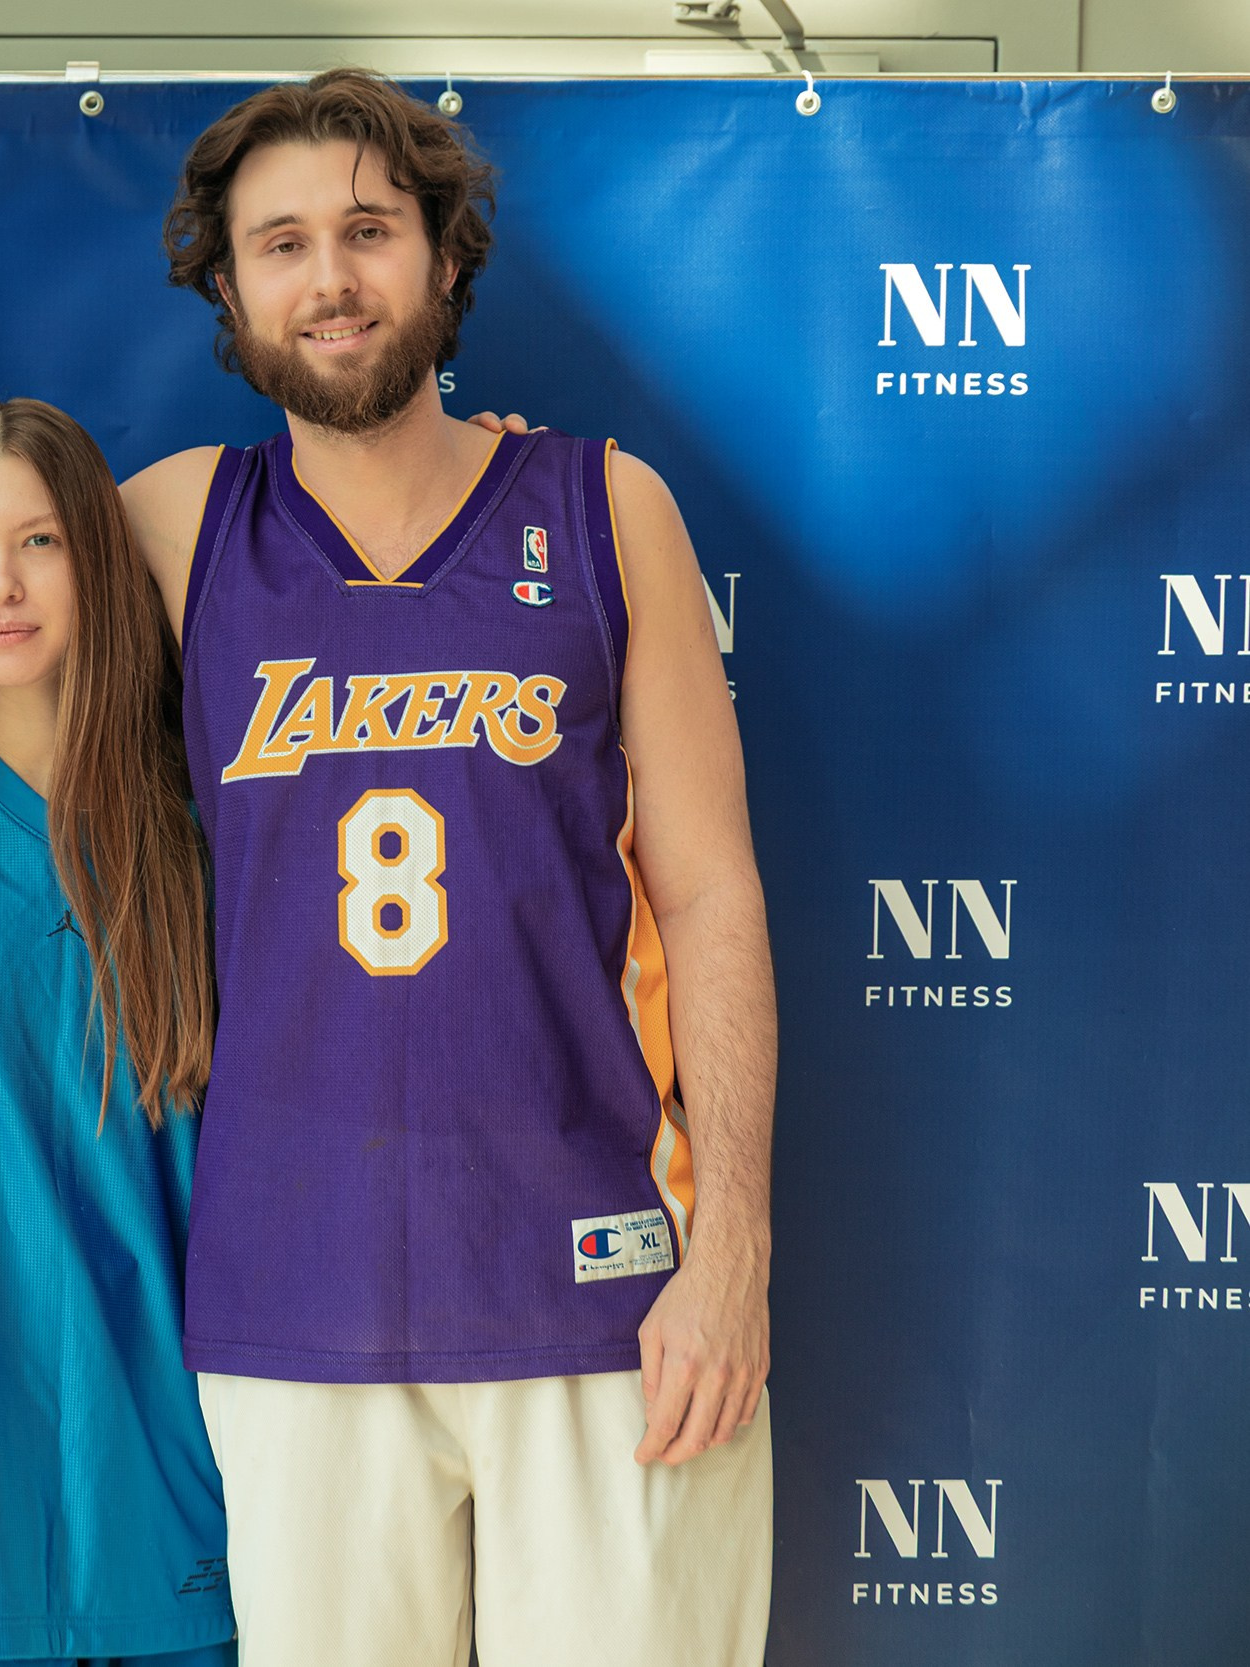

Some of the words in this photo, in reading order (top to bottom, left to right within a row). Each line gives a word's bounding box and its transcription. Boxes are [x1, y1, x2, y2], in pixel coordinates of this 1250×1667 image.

[878, 263, 1031, 347] NN
[877, 372, 1029, 396] FITNESS
[221, 657, 567, 784] LAKERS
[337, 787, 449, 977] 8
[866, 879, 1018, 960] NN
[865, 985, 1013, 1007] FITNESS
[640, 1232, 661, 1250] XL
[1139, 1287, 1250, 1310] FITNE
[854, 1479, 1003, 1559] NN
[852, 1582, 998, 1605] FITNESS
